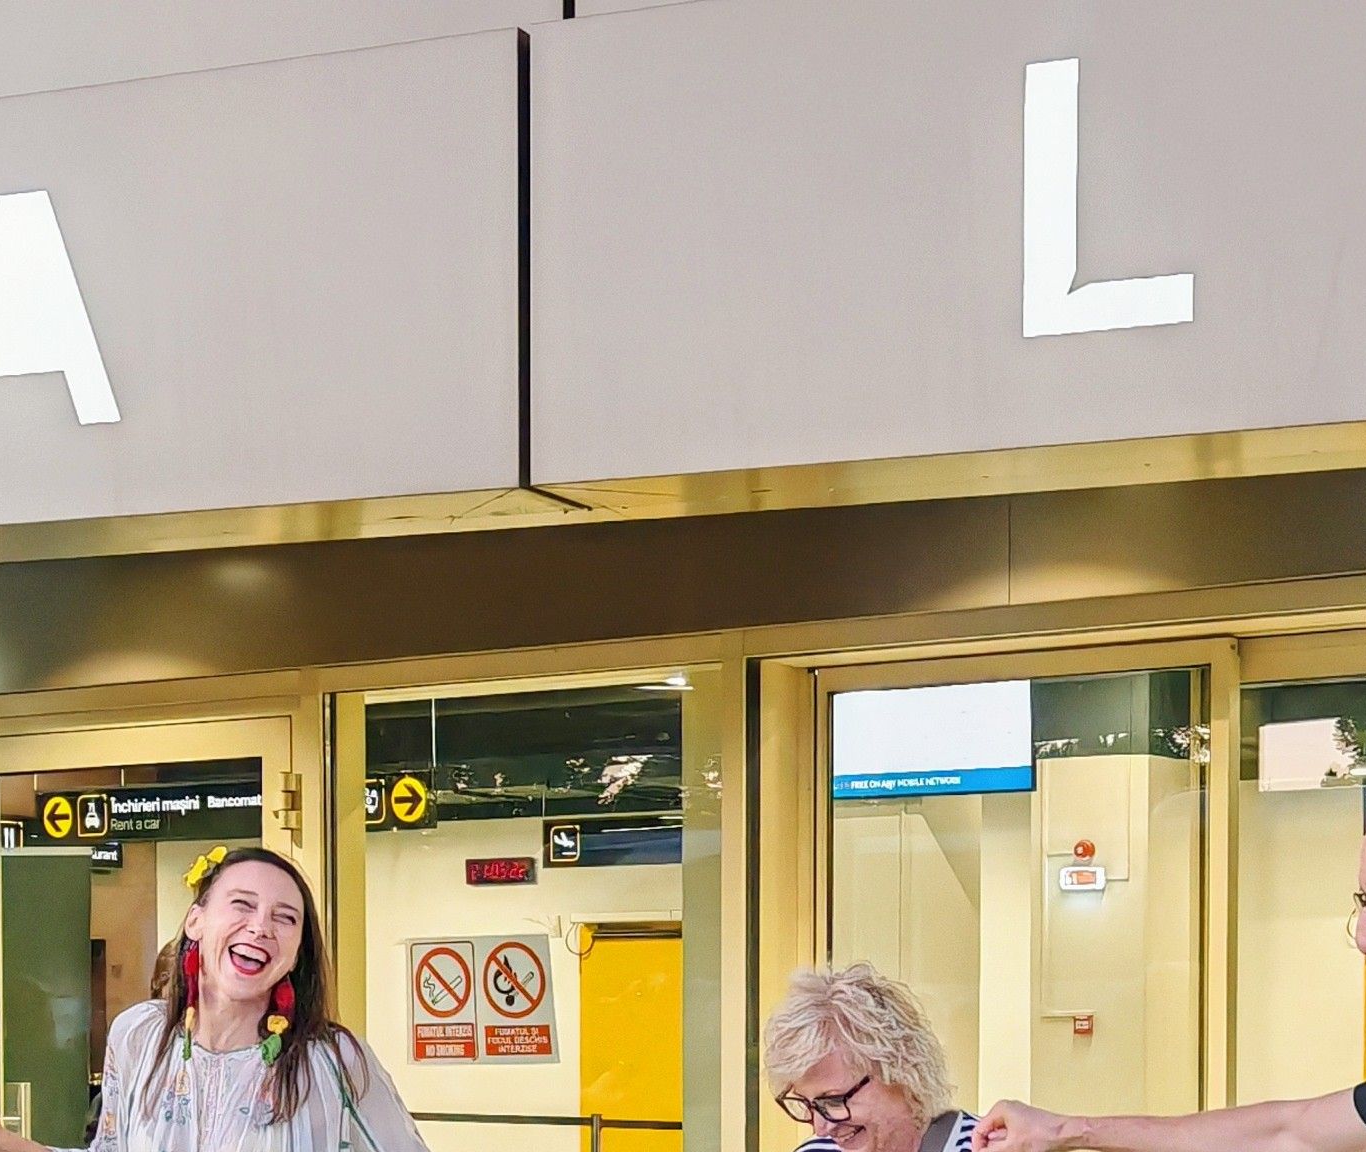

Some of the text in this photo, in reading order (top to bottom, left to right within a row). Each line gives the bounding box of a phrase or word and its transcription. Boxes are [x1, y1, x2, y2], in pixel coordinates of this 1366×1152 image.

[850, 780, 869, 790] FREE
[870, 780, 880, 789] ON
[897, 778, 925, 788] MOBILE
[110, 796, 160, 814] Închirieri
[207, 794, 263, 809] Bancomat
[110, 818, 161, 831] Rent a car
